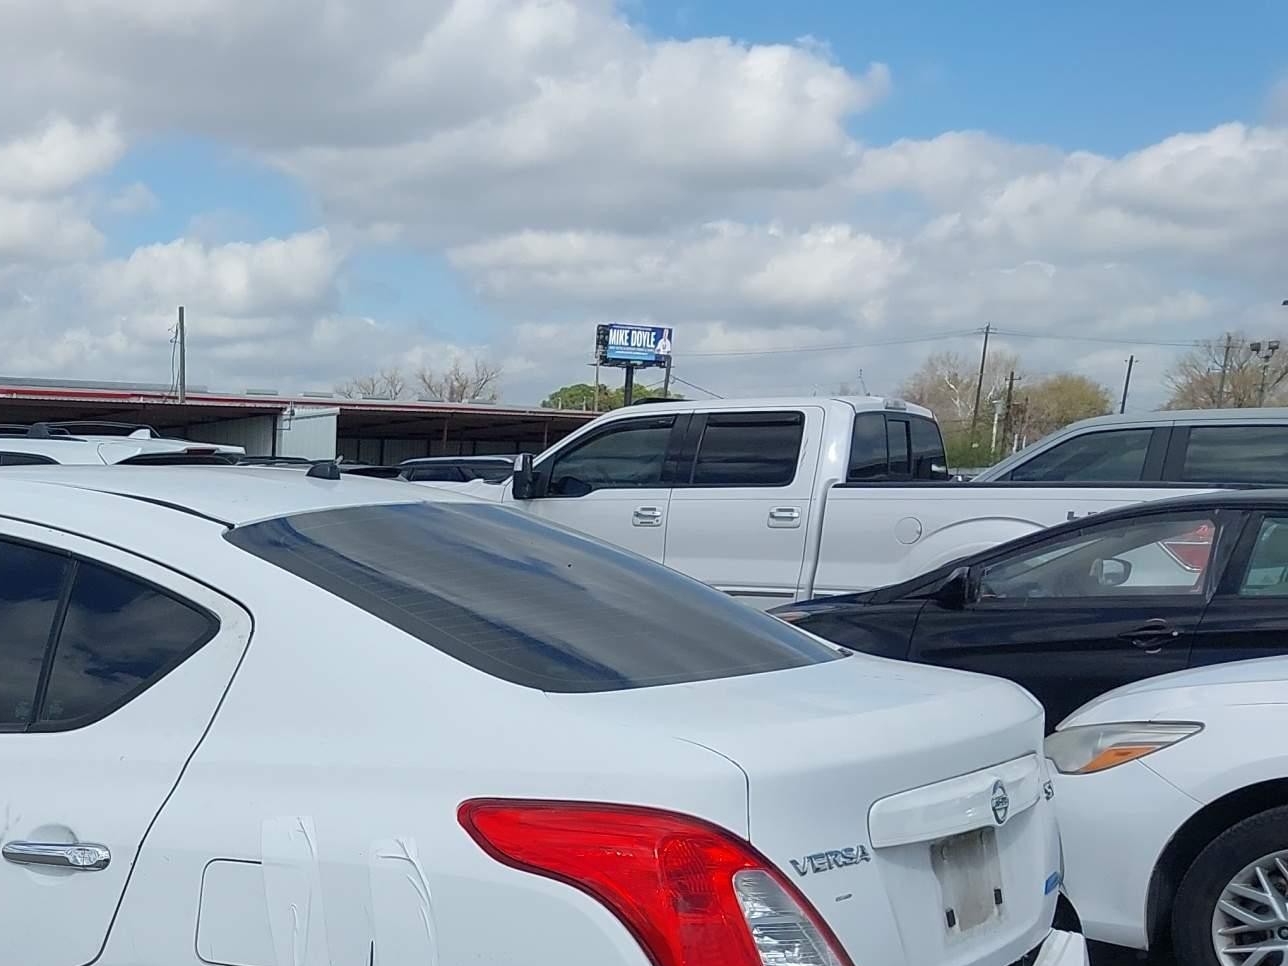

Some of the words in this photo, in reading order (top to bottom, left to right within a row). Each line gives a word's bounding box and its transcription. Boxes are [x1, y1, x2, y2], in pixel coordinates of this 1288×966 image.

[608, 328, 630, 346] MIKE
[631, 330, 656, 348] DOYLE
[789, 844, 871, 876] VERSA
